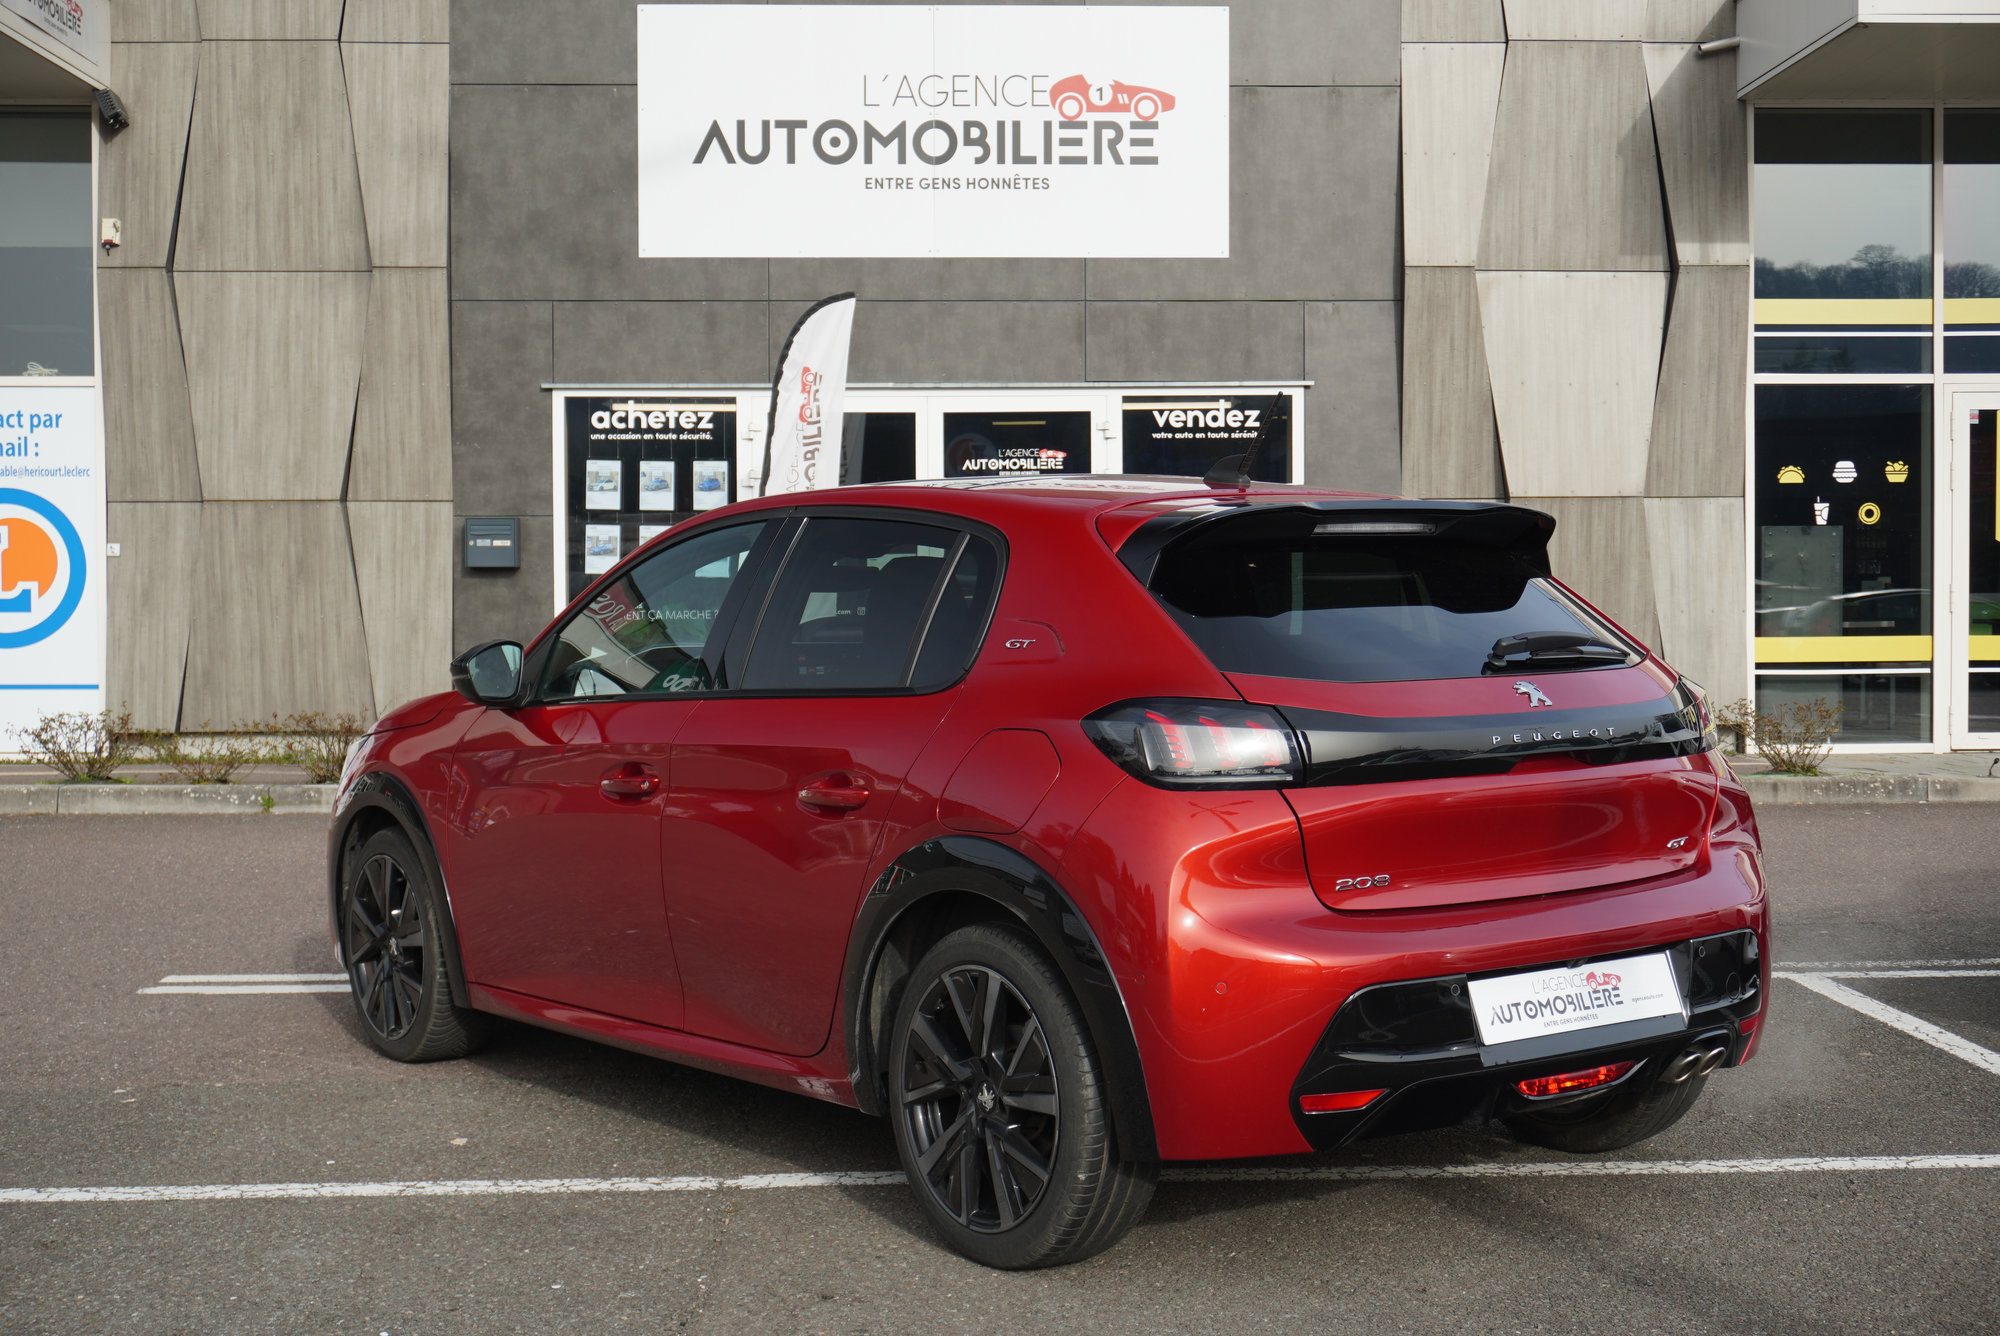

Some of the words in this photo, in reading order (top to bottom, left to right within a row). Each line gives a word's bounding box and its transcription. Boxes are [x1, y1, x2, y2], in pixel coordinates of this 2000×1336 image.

[863, 73, 1050, 108] L'AGENCE
[864, 177, 914, 190] ENTRE
[918, 177, 961, 190] GENS
[965, 173, 1050, 190] HONNÊTES
[590, 400, 714, 429] achetez
[1151, 399, 1261, 428] vendez
[29, 413, 63, 434] par
[607, 431, 641, 440] occasion
[655, 432, 678, 440] toute
[1174, 431, 1194, 439] auto
[1207, 431, 1229, 439] toute
[1230, 430, 1265, 439] sérénit.
[0, 436, 28, 457] ail
[998, 448, 1040, 457] L'AGENCE
[647, 609, 663, 623] ÇA
[664, 609, 711, 620] MARCHE
[1005, 638, 1036, 649] GT
[1491, 726, 1617, 745] PEUGEOT
[1667, 836, 1689, 850] GT
[1335, 874, 1391, 892] 208
[1531, 972, 1588, 995] L'AGENCE
[1543, 1020, 1559, 1028] ENTRE
[1559, 1017, 1573, 1026] GENS
[1573, 1013, 1599, 1024] HONNÊTES
